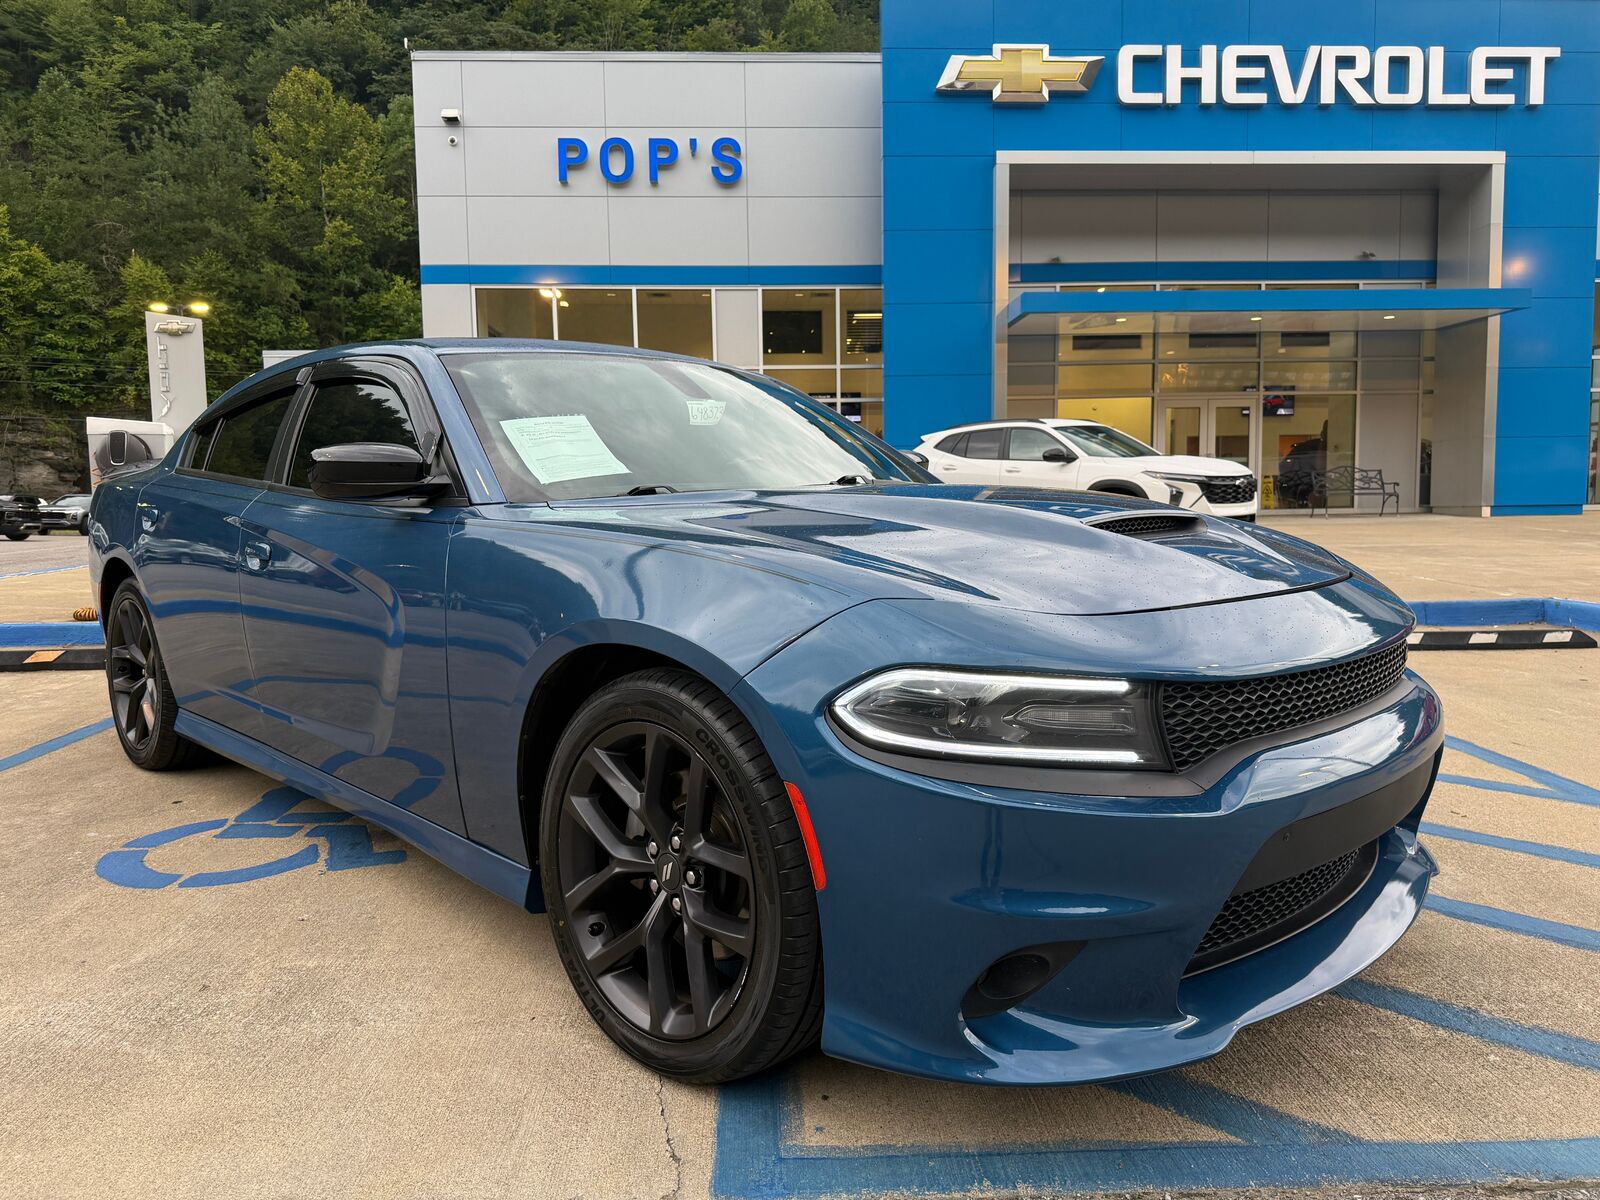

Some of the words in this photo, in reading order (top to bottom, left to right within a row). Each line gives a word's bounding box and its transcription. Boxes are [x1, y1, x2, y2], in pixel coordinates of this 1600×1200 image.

[1117, 44, 1562, 106] CHEVROLET
[557, 136, 743, 186] POP'S
[695, 727, 770, 873] CROSSWIND
